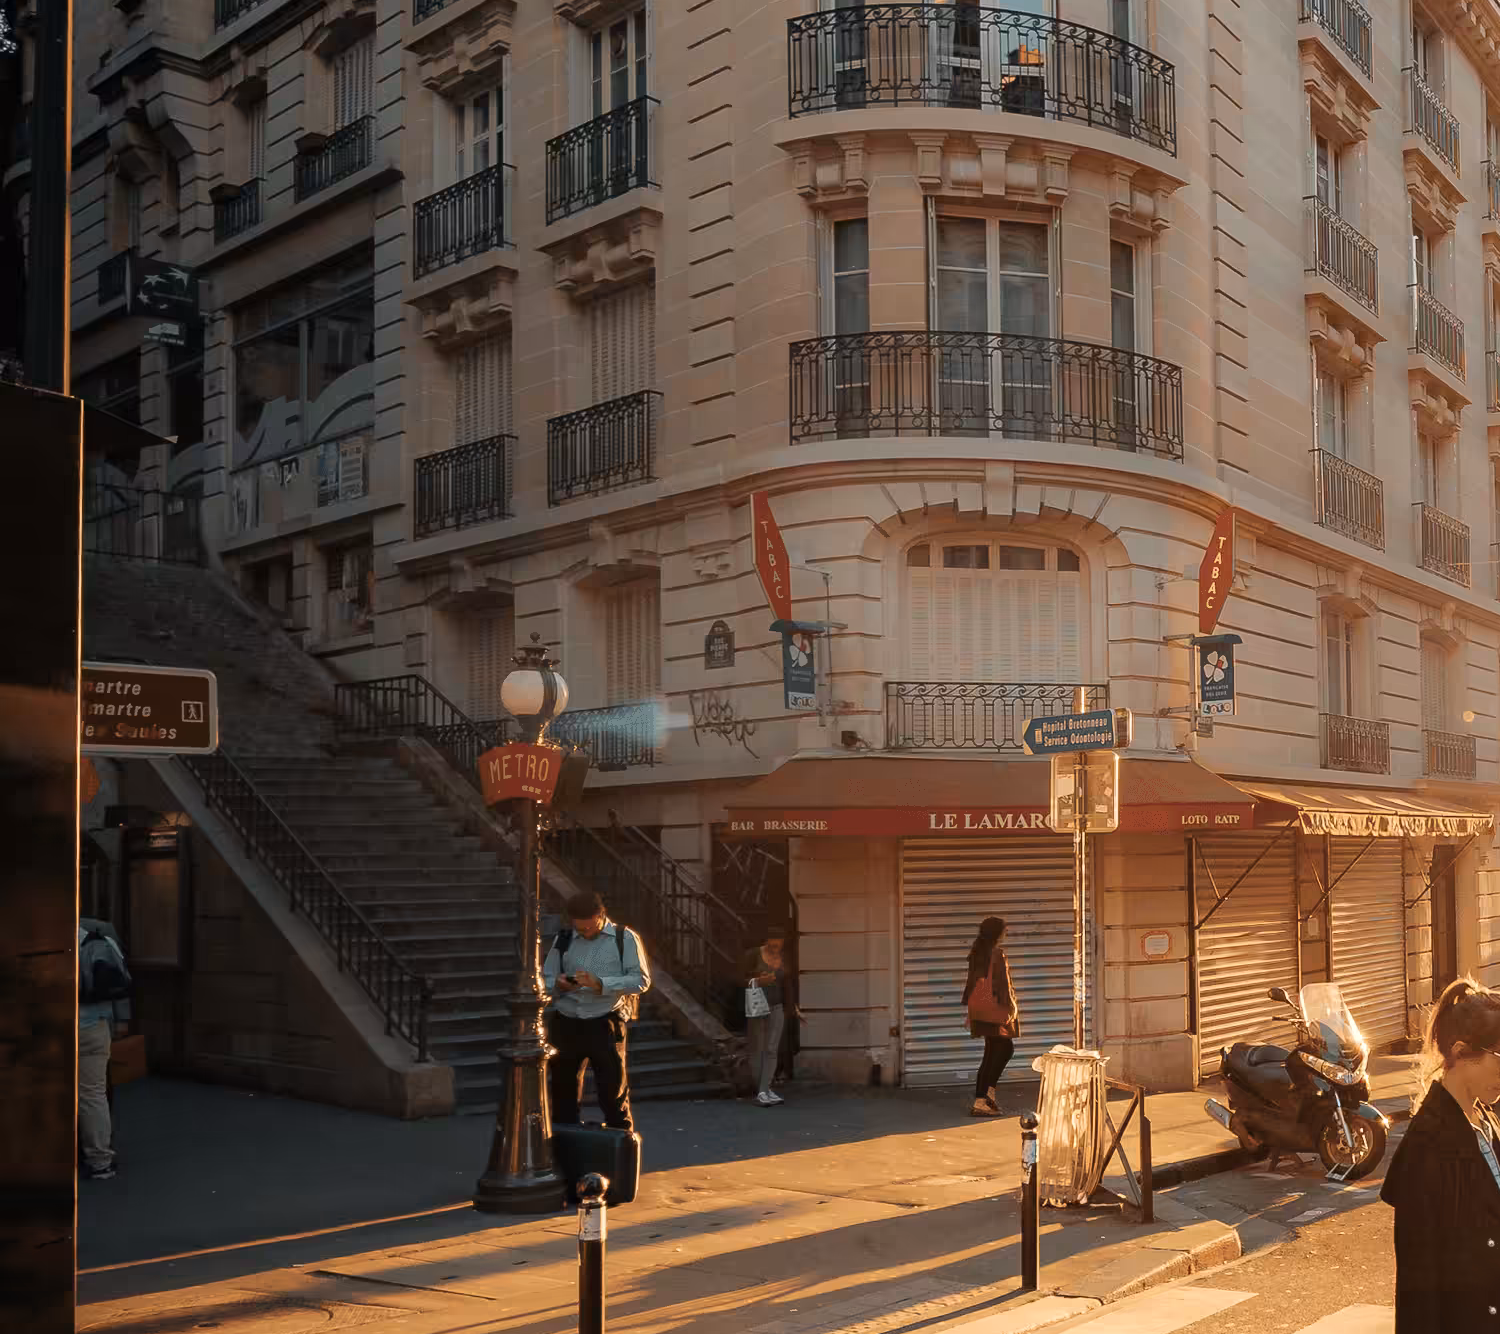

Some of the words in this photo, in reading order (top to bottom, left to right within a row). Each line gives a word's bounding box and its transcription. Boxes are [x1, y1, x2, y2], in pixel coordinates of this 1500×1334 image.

[760, 520, 784, 599] TABAC
[1206, 536, 1227, 609] TABAC
[1068, 718, 1108, 730] Bretonneau
[1044, 736, 1068, 747] Service
[1070, 730, 1112, 745] Odontologie
[731, 821, 754, 831] BAR
[763, 820, 828, 831] BRASSERIE
[928, 813, 958, 829] LE
[1181, 814, 1208, 825] LOTO
[1214, 814, 1240, 824] RATP
